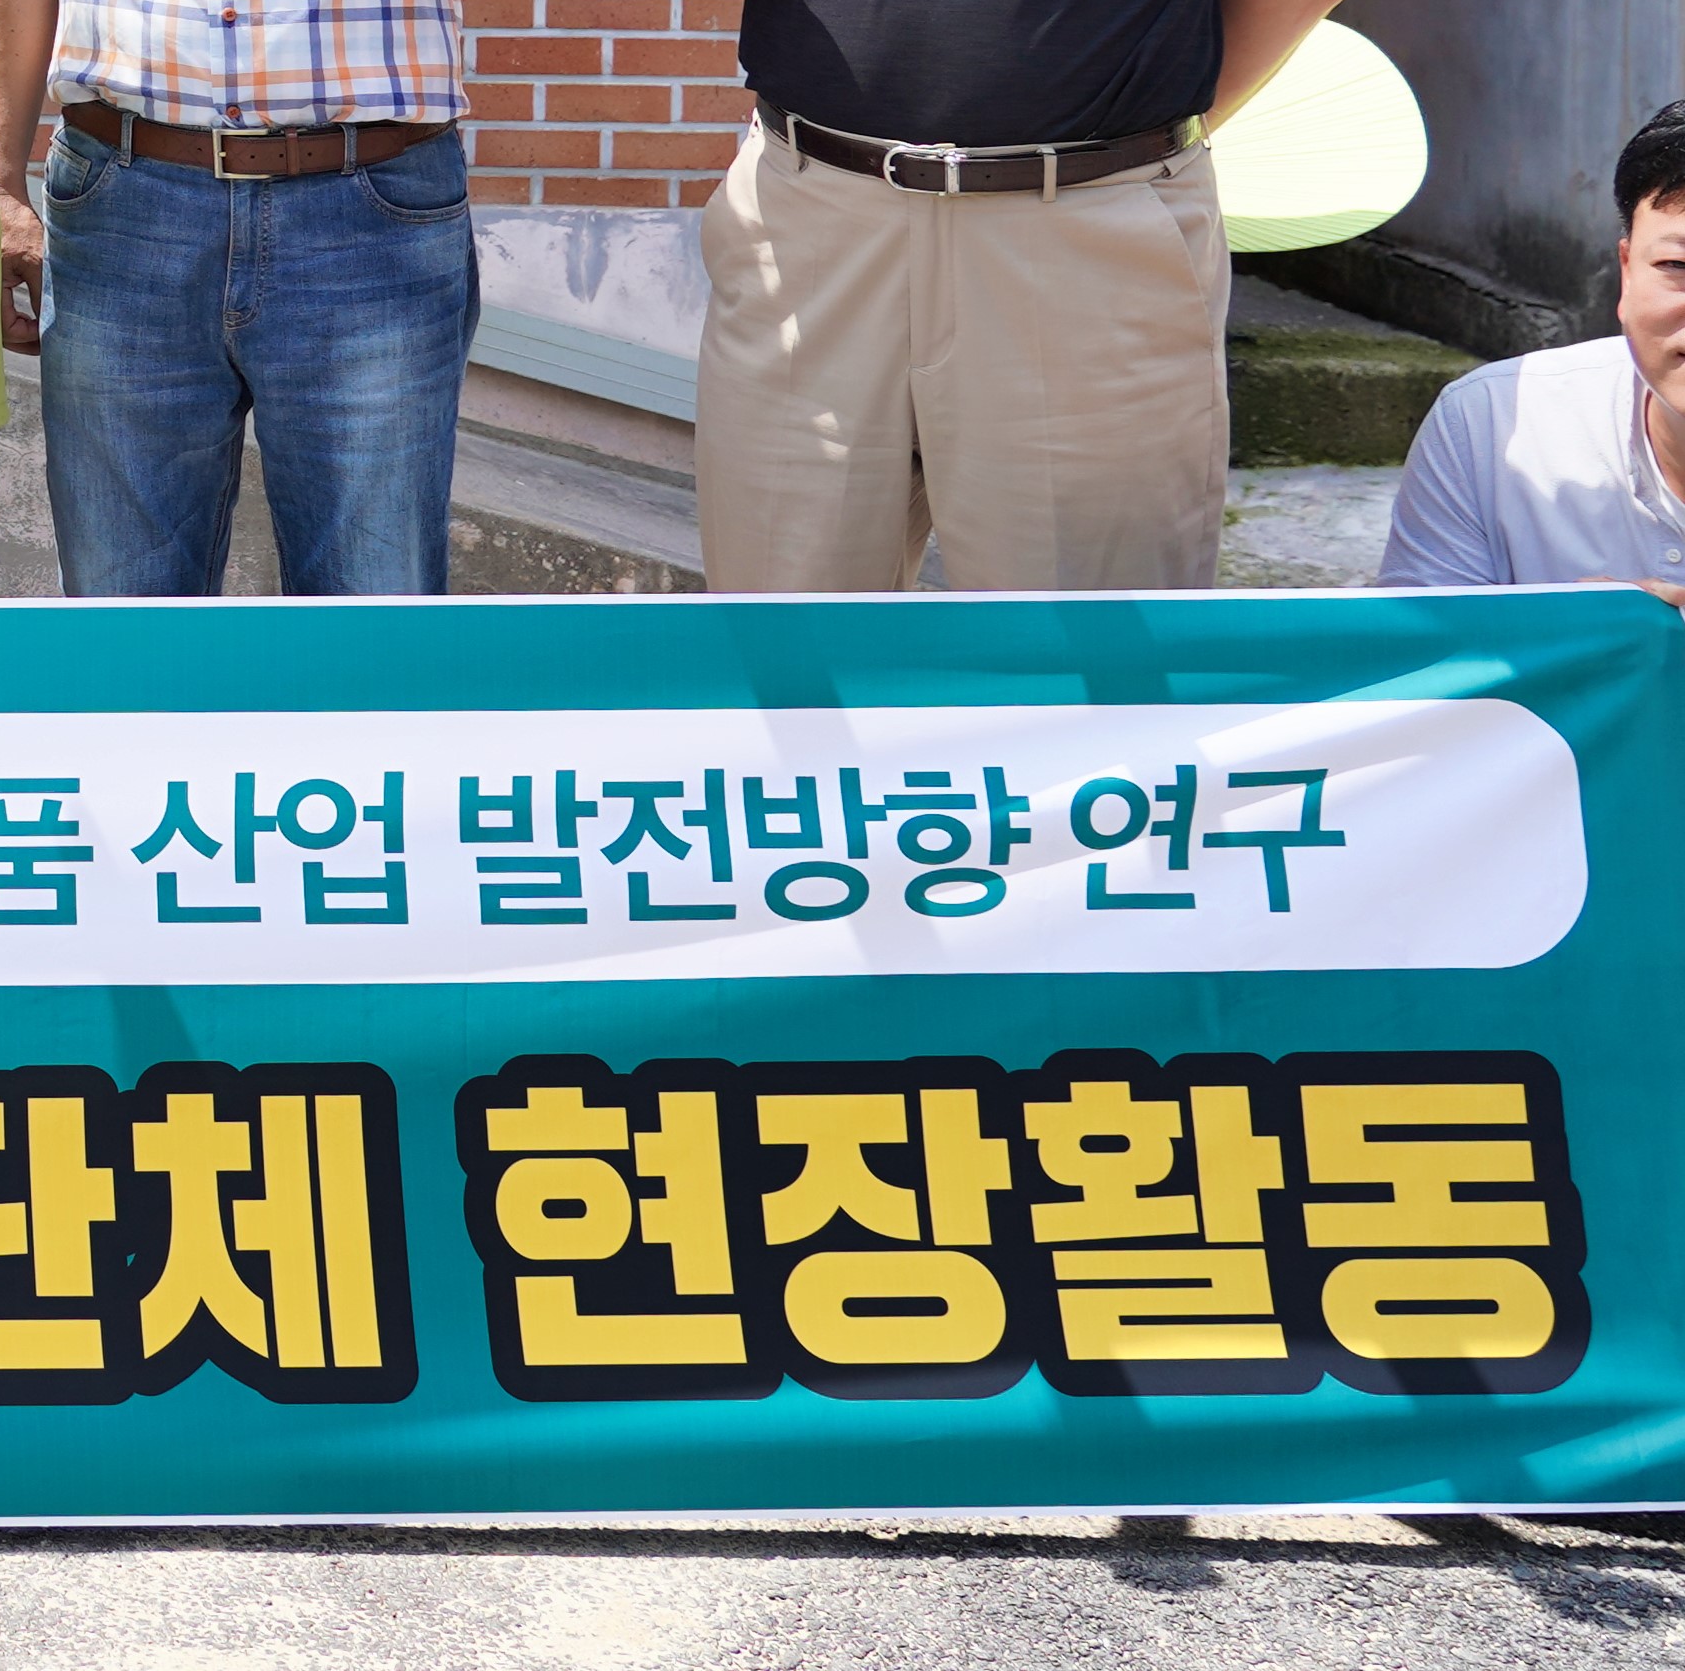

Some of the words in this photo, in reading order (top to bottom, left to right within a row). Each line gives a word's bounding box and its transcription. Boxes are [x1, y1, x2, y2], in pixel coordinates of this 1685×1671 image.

[129, 770, 411, 930] 산업
[457, 765, 1031, 926] 발전방향
[1065, 764, 1348, 918] 연구
[486, 1081, 1557, 1368] 현장활동
